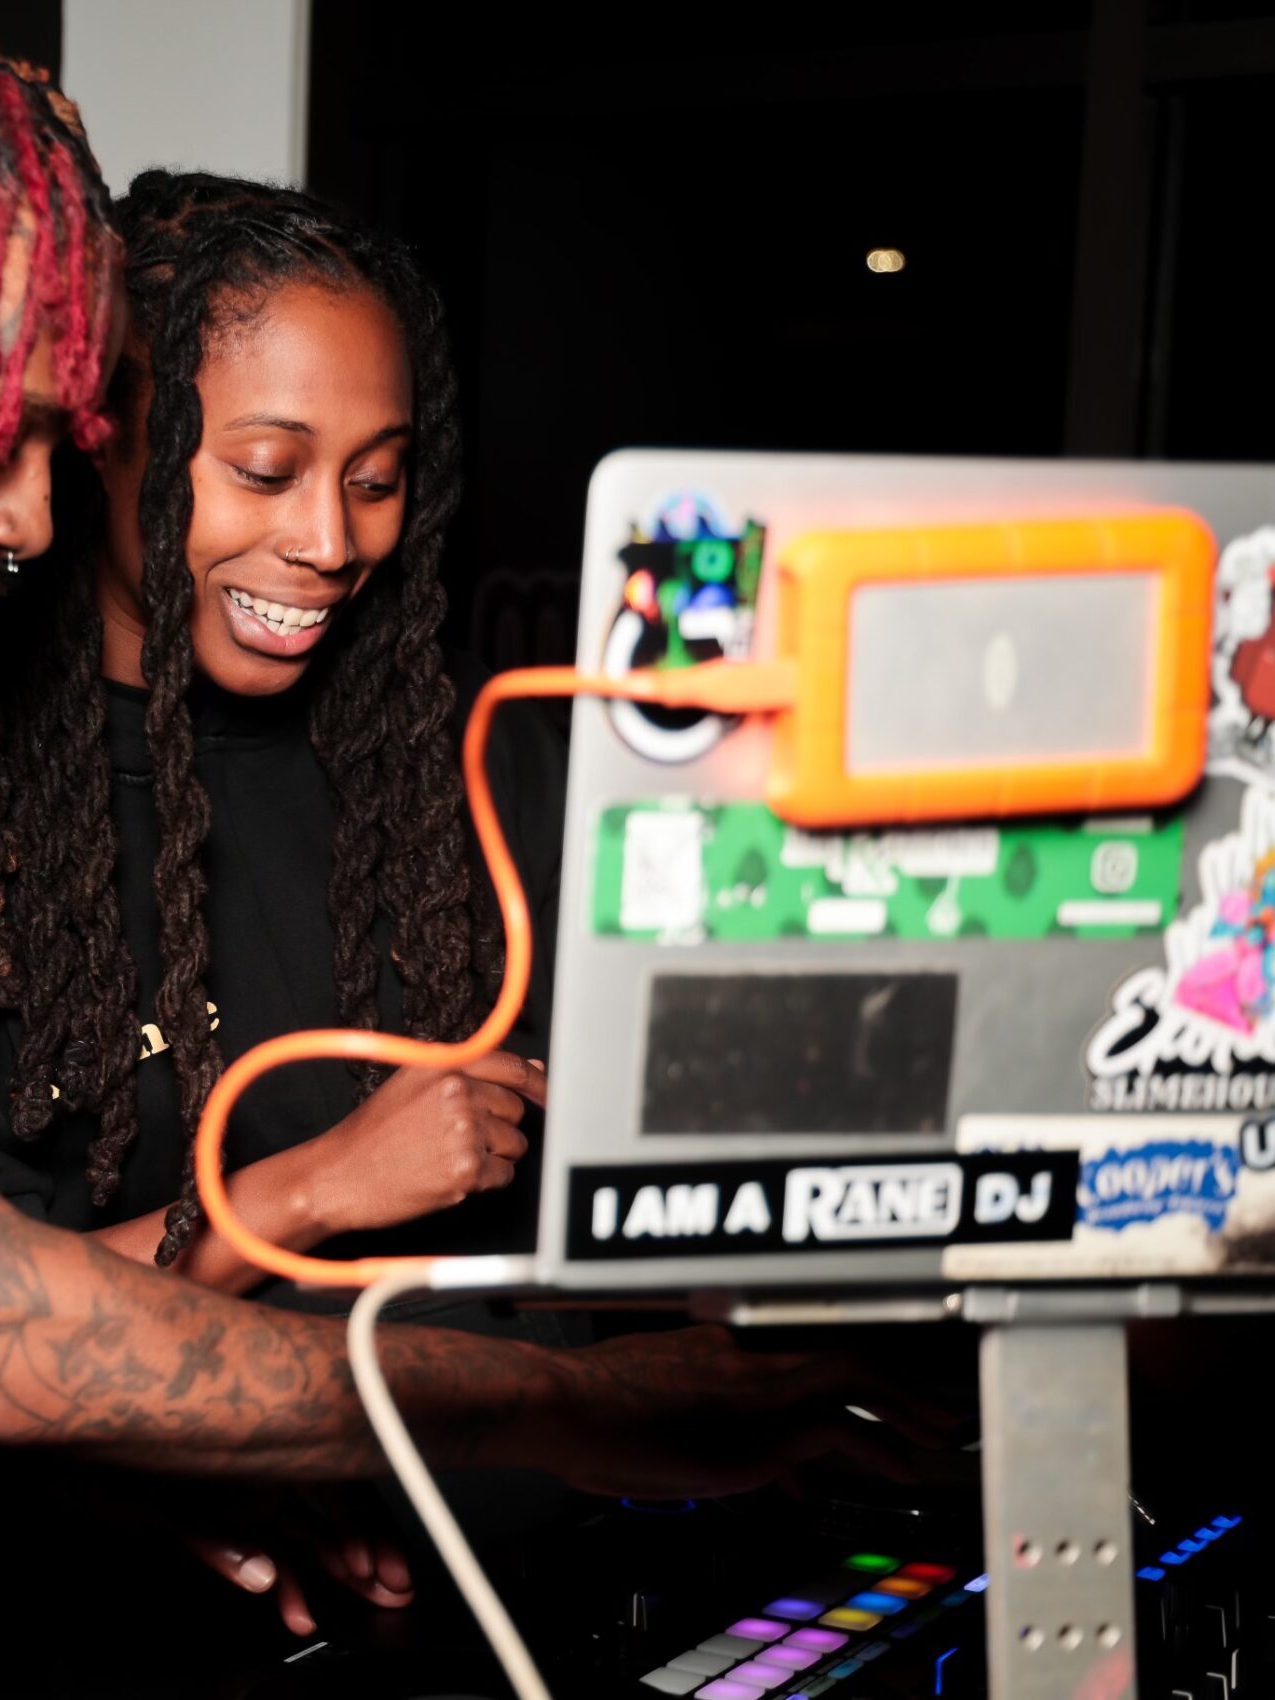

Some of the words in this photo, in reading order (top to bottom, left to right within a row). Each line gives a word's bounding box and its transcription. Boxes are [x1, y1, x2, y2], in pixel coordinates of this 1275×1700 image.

[592, 1187, 618, 1240] I
[622, 1183, 719, 1238] AM
[724, 1181, 771, 1234] A
[782, 1162, 963, 1242] RANE
[975, 1171, 1052, 1224] DJ
